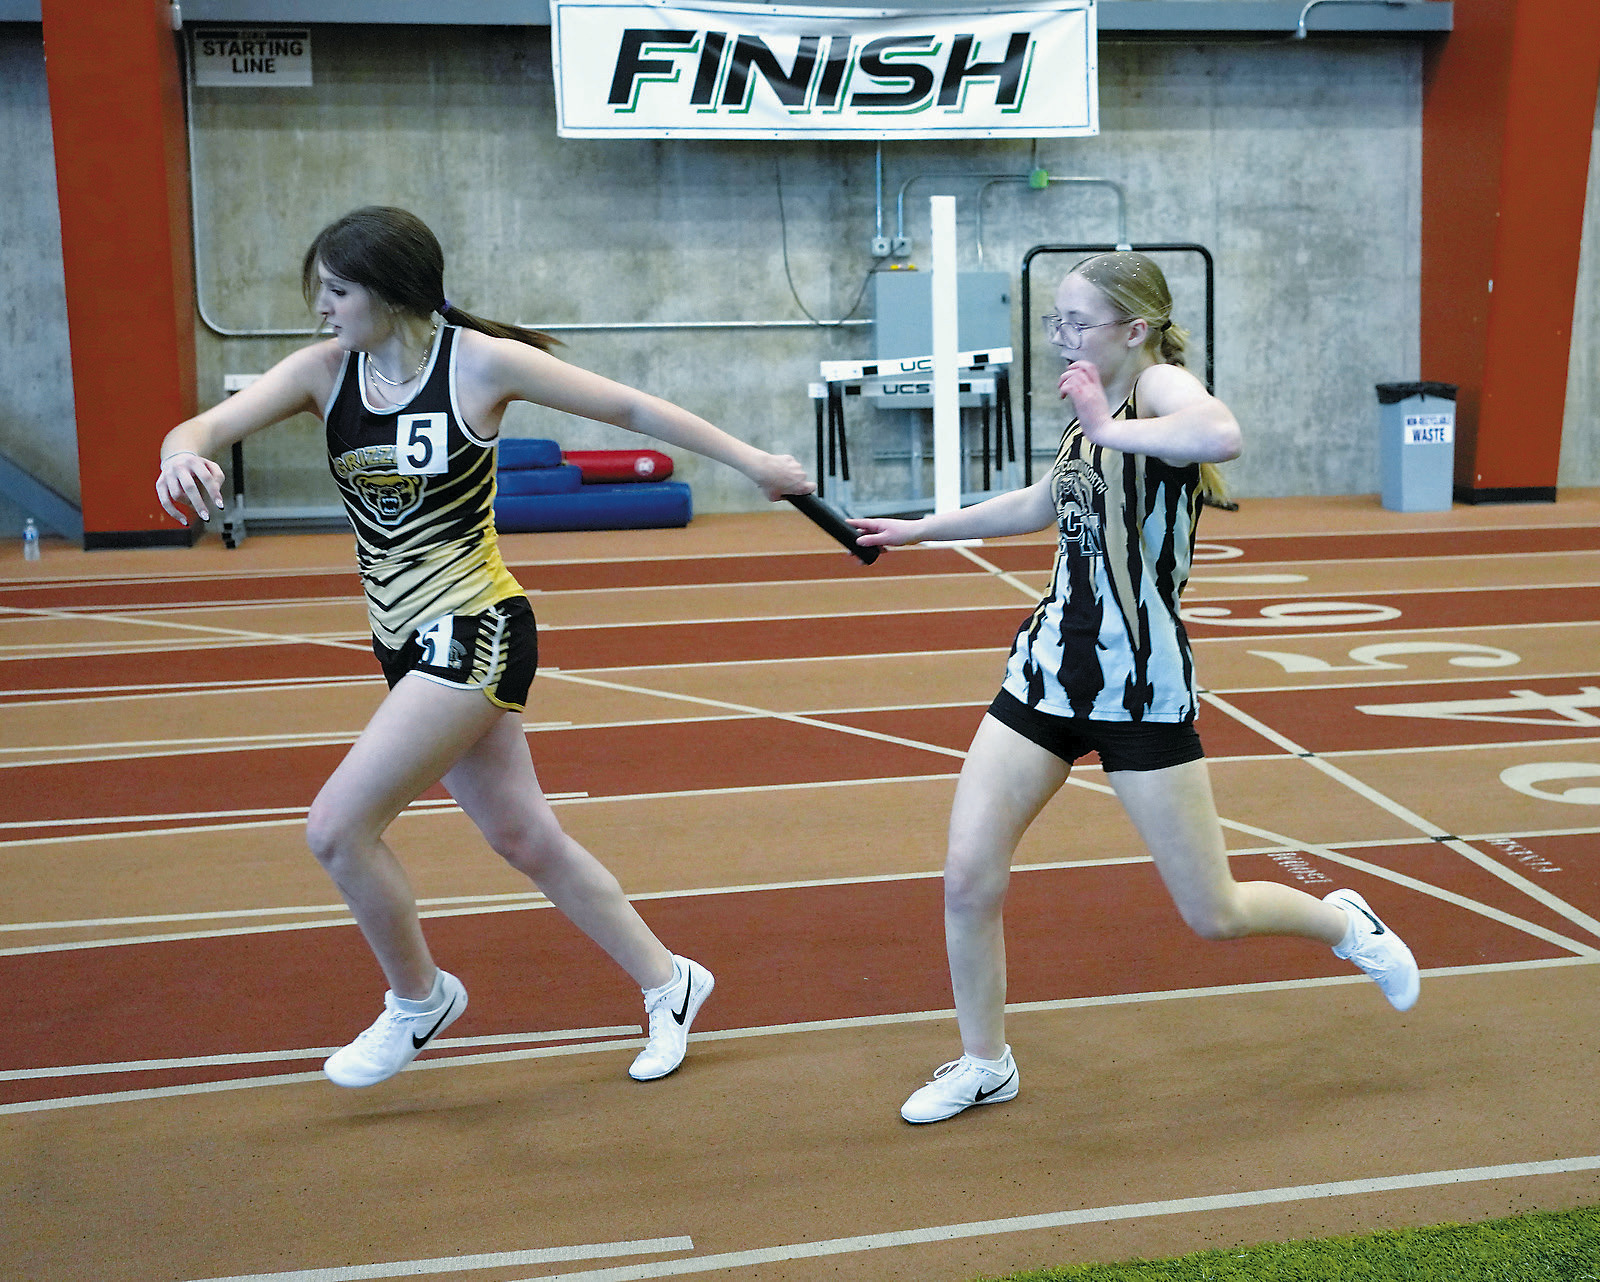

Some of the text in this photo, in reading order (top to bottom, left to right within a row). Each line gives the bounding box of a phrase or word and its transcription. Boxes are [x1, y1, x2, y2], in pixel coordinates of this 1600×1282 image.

[202, 40, 304, 57] STARTING
[232, 57, 276, 73] LINE
[607, 28, 1036, 114] FINISH
[900, 359, 932, 372] UC
[883, 383, 931, 395] UCS
[406, 419, 433, 469] 5
[1412, 427, 1445, 441] WASTE
[1178, 601, 1403, 628] 6
[1246, 641, 1522, 674] 5
[1354, 686, 1600, 729] 4
